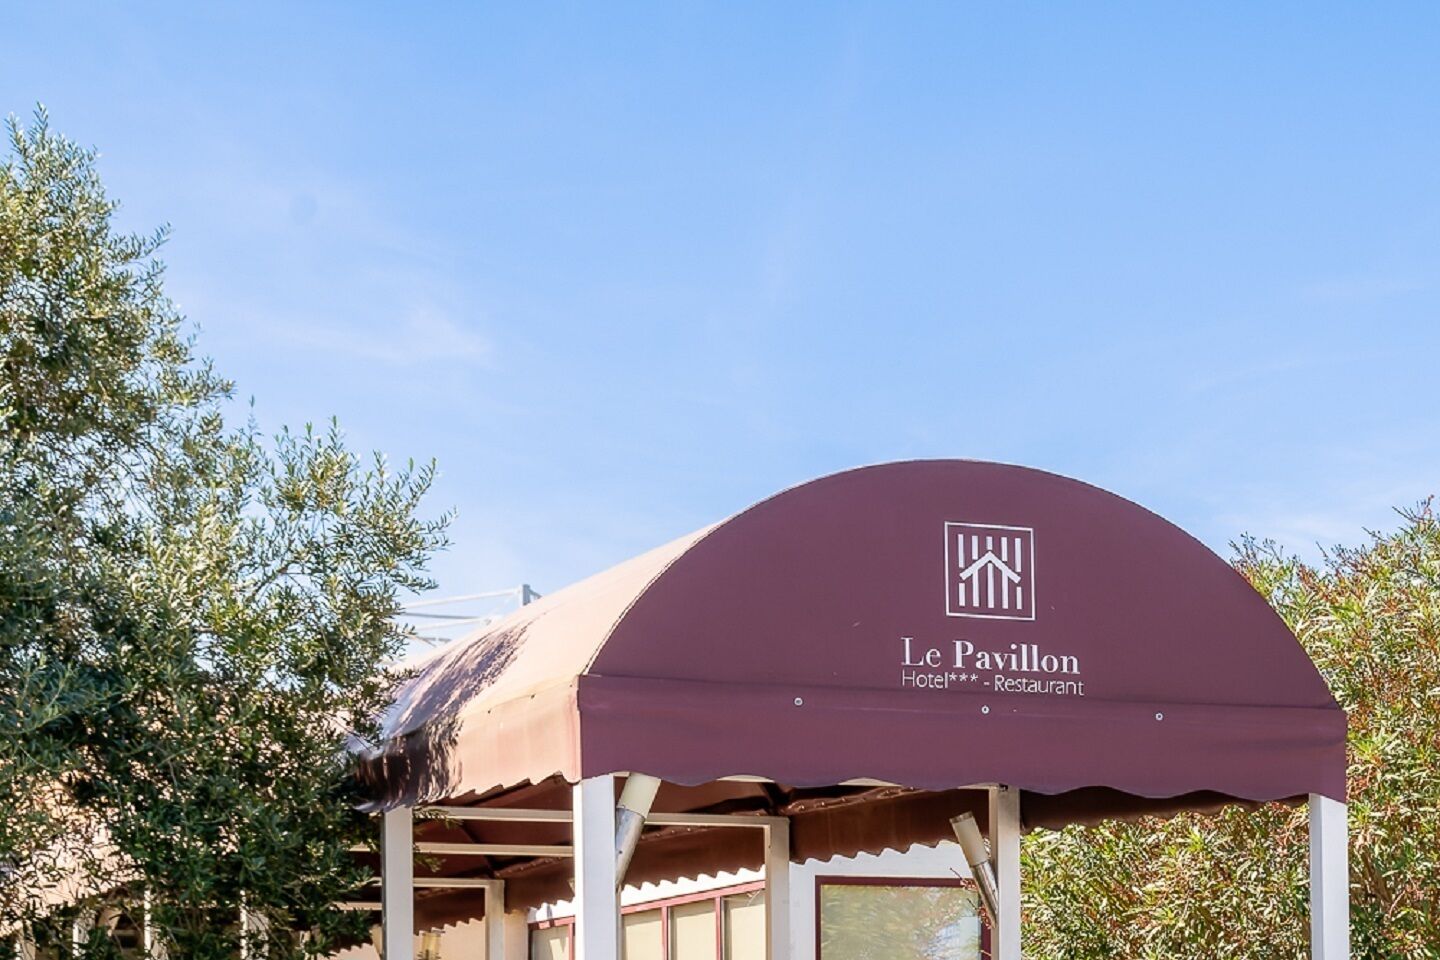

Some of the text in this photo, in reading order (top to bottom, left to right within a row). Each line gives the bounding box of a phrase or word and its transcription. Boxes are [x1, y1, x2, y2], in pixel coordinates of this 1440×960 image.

[901, 637, 1081, 675] Le Pavillon
[994, 675, 1085, 696] Restaurant
